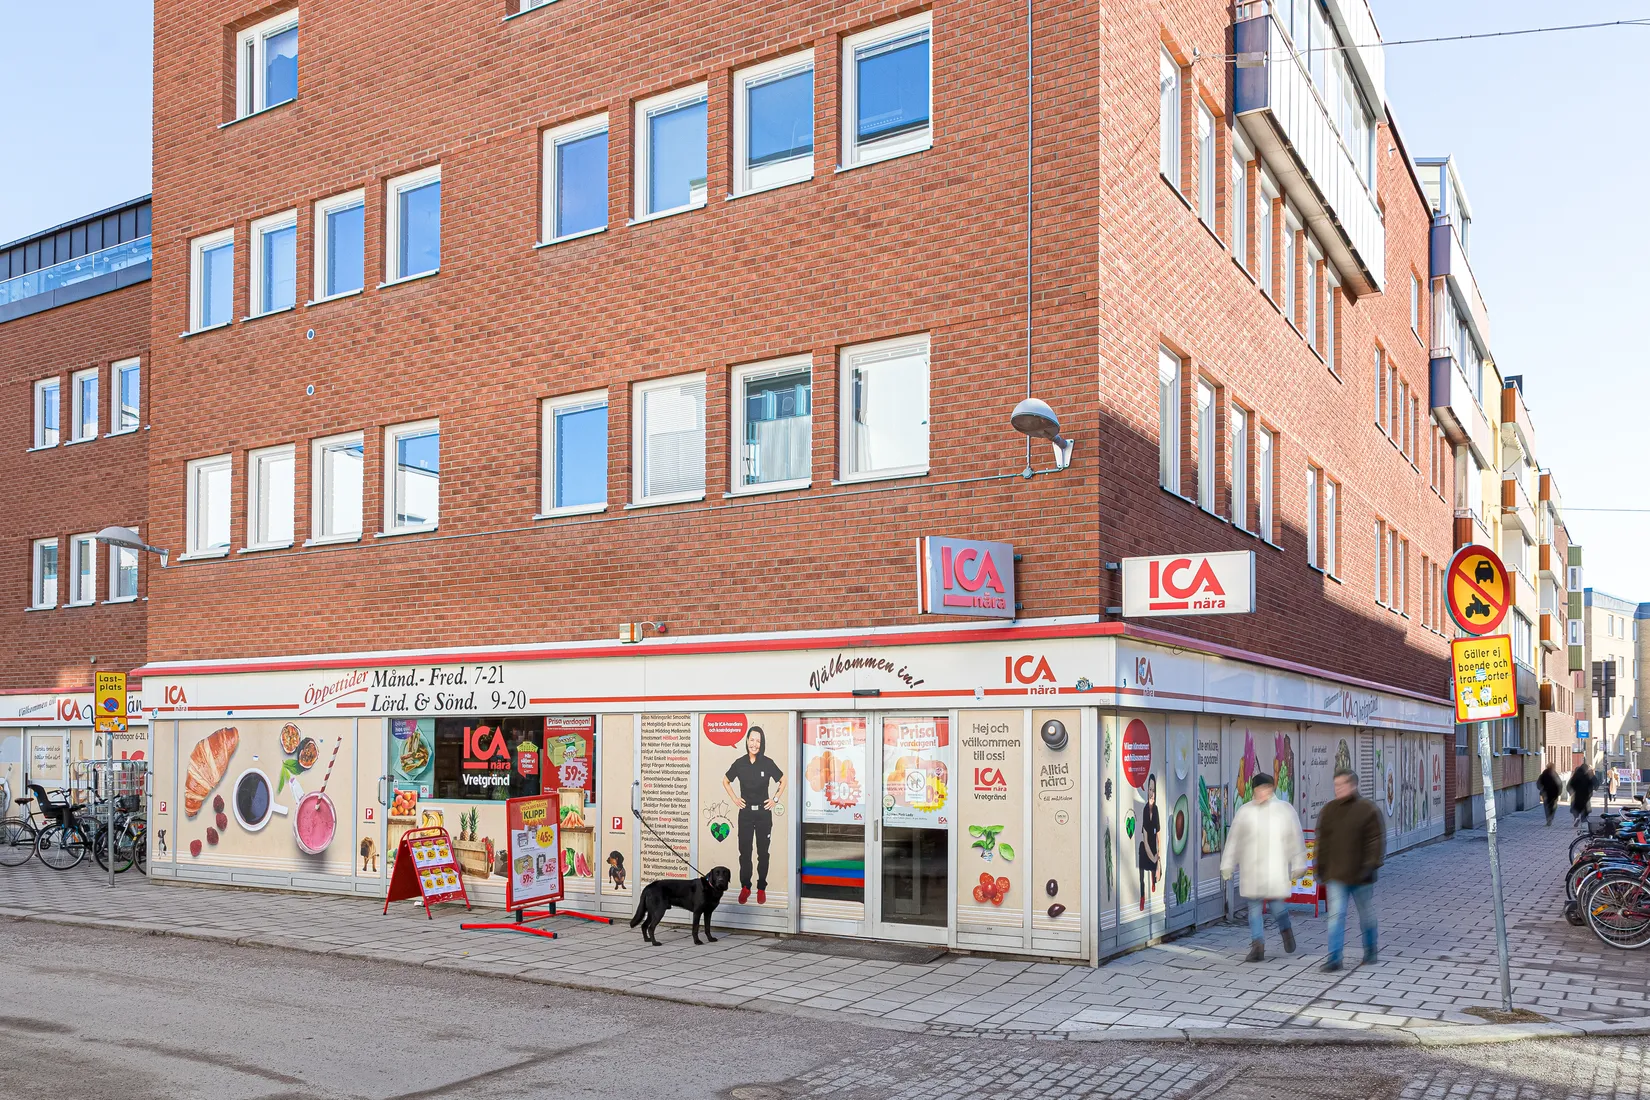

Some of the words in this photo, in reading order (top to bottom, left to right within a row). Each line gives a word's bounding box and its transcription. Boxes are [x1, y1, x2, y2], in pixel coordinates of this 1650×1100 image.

[941, 546, 1006, 594] ICA
[1149, 557, 1226, 599] ICA
[972, 592, 1007, 610] nära
[1193, 598, 1226, 610] nära
[1464, 649, 1490, 660] Gäller
[1493, 647, 1501, 658] ej
[809, 653, 895, 691] Välkommen
[897, 665, 925, 689] in!
[1005, 655, 1058, 685] ICA
[1135, 656, 1154, 687] ICA
[1458, 661, 1491, 672] boende
[1493, 659, 1508, 668] och
[371, 669, 425, 688] Månd.-
[428, 667, 468, 686] Fred.
[474, 665, 505, 685] 7-21
[304, 669, 369, 704] Öppettider
[1029, 685, 1058, 696] nära
[165, 685, 188, 705] ICA
[371, 693, 410, 712] Lörd.
[414, 692, 431, 712] &
[434, 692, 478, 711] Sönd.
[491, 690, 526, 710] 9-20
[57, 699, 82, 721] ICA
[1342, 691, 1354, 719] ICA
[548, 717, 562, 725] Prisa
[562, 717, 591, 726] vardagen!
[818, 724, 851, 739] Prisa
[900, 724, 935, 739] Prisa
[972, 723, 989, 736] Hej
[990, 723, 1009, 733] och
[463, 725, 511, 761] ICA
[900, 738, 937, 748] vardagen!
[962, 737, 1020, 748] välkommen
[973, 751, 985, 761] till
[986, 751, 1005, 761] oss!
[490, 761, 512, 769] nära
[1040, 763, 1069, 776] Alltid
[564, 766, 585, 781] 59:-
[974, 767, 1007, 787] ICA
[462, 774, 510, 788] Vretgränd
[1040, 776, 1067, 788] nära
[974, 793, 1007, 801] Vretgränd
[160, 803, 165, 811] P
[366, 809, 372, 819] P
[523, 809, 545, 820] KLIPP!
[614, 818, 621, 829] P
[540, 832, 553, 843] 45:-
[522, 874, 534, 884] 59:-
